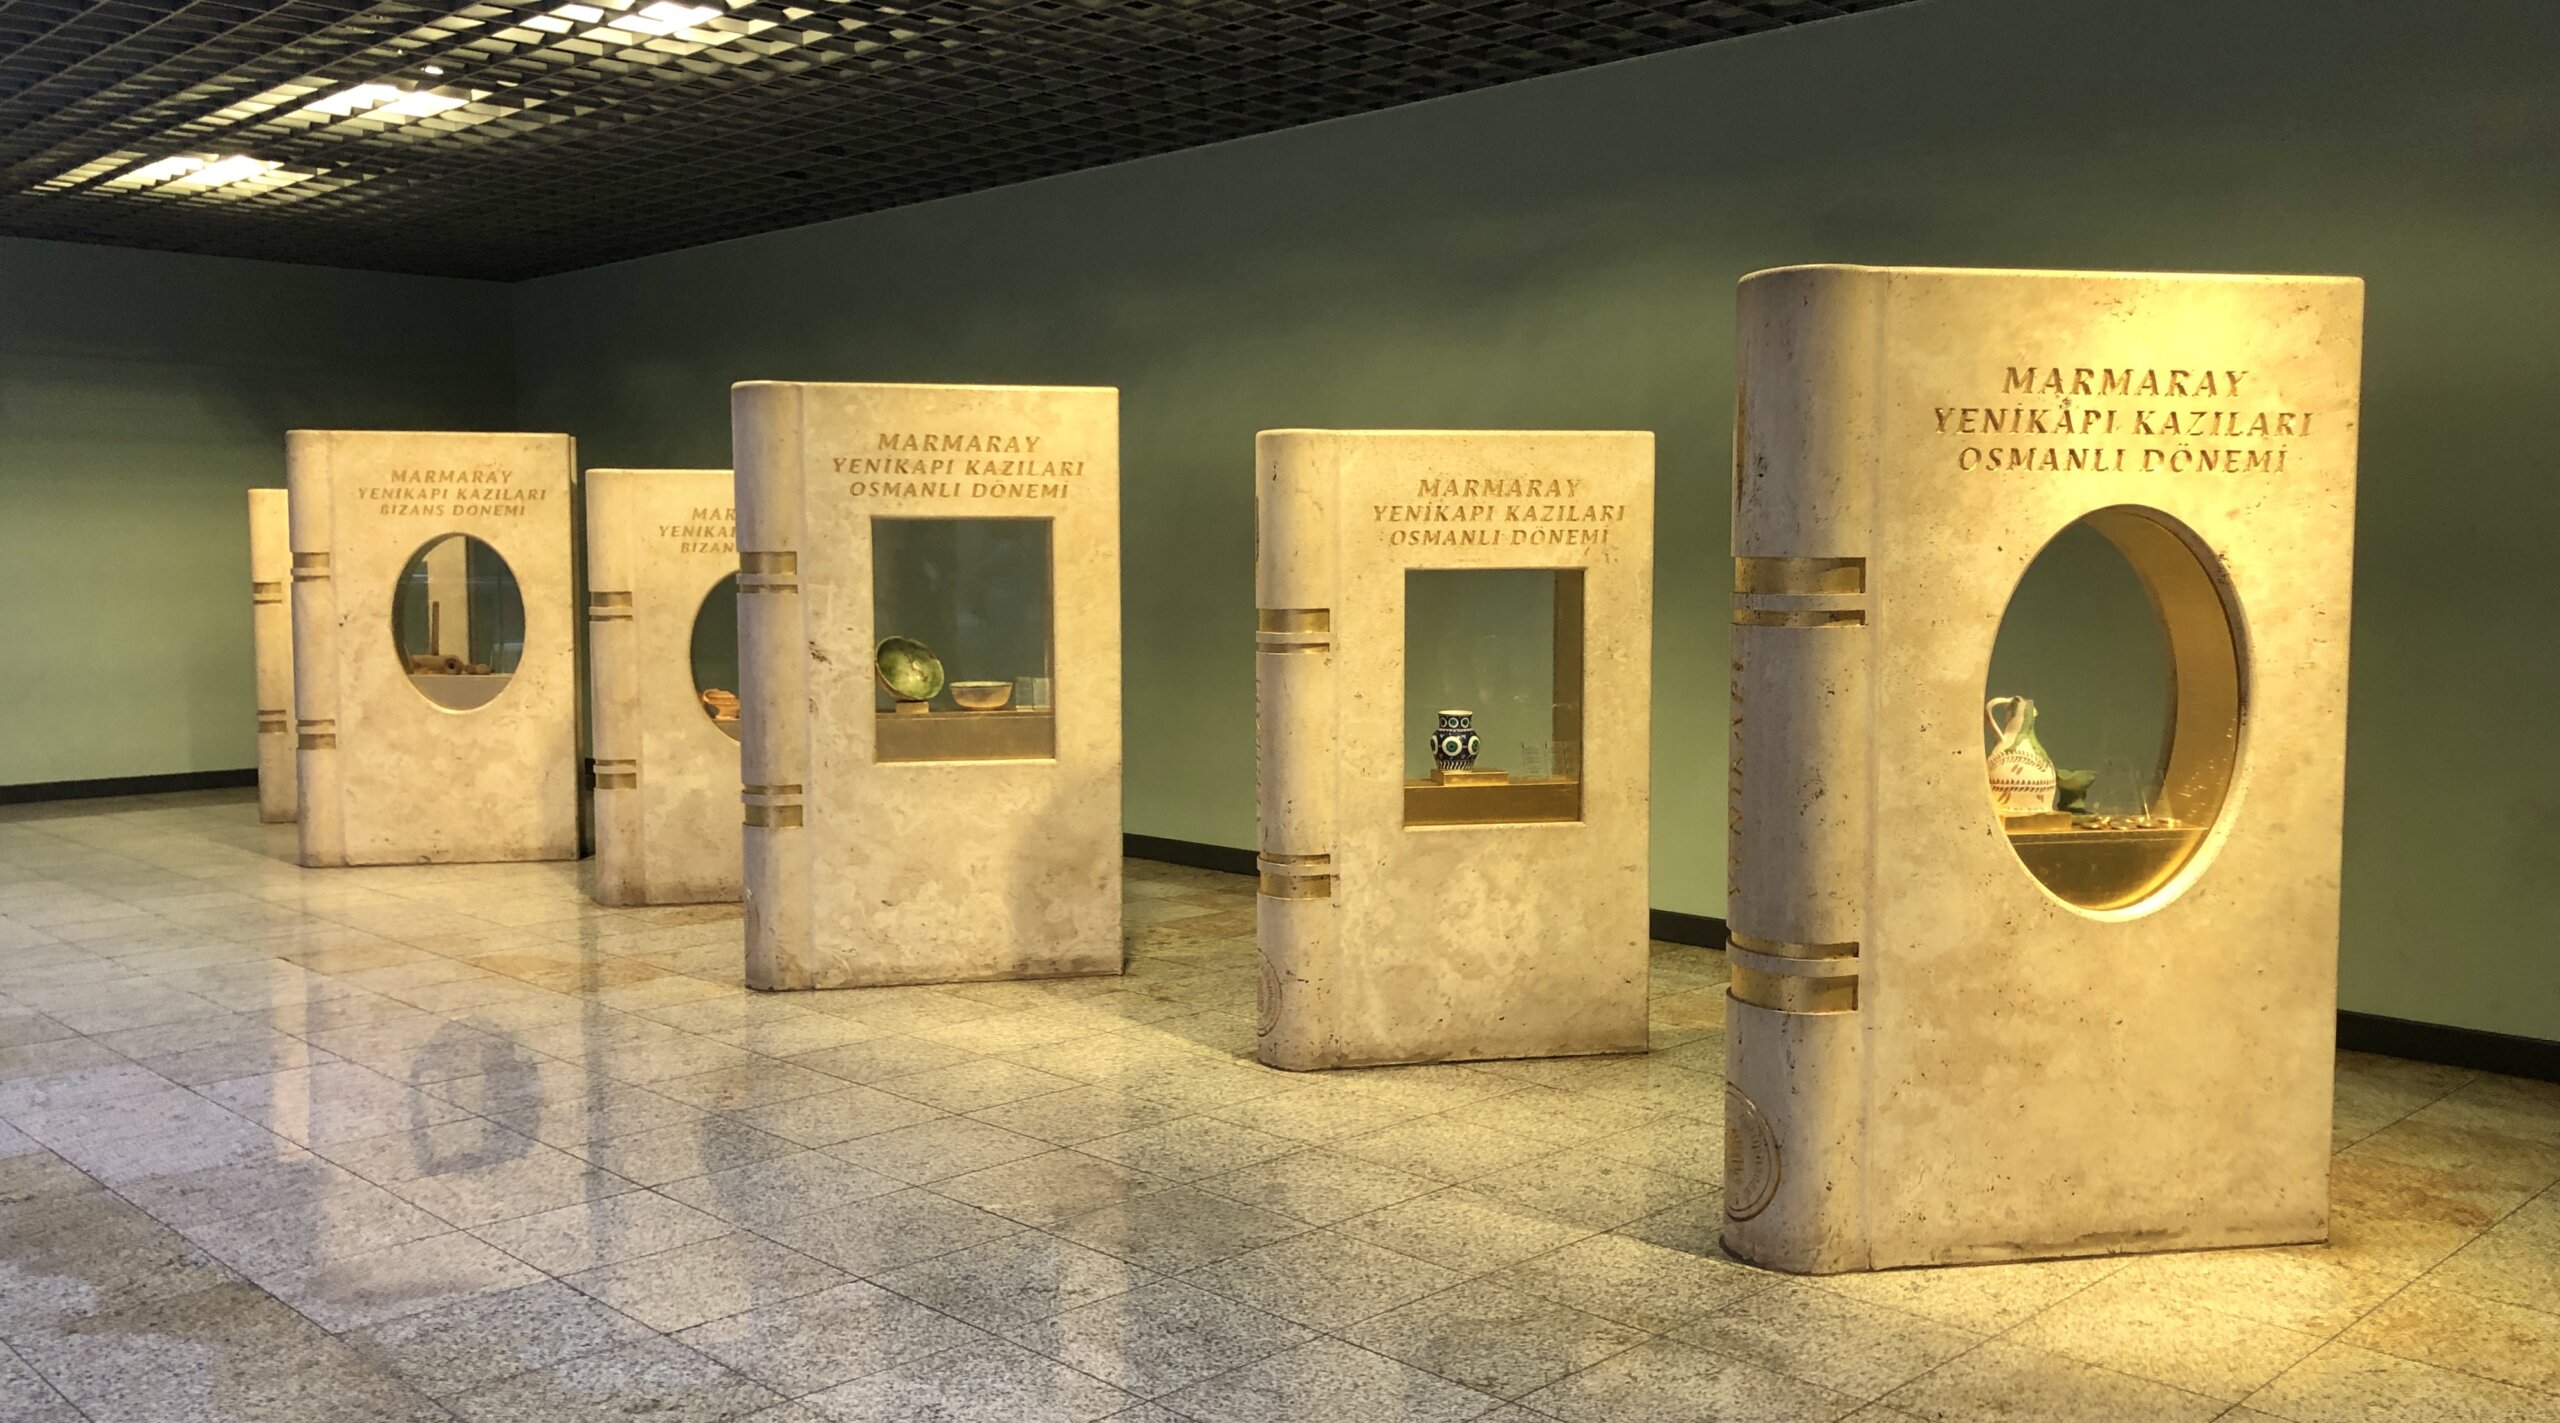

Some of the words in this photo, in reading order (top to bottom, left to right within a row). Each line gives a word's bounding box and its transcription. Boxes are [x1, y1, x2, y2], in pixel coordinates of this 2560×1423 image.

[2001, 366, 2248, 397] MARMARAY
[1933, 402, 2117, 436] YENİKAPI
[2132, 410, 2314, 437] KAZILARI
[878, 433, 1041, 453] MARMARAY
[1958, 446, 2126, 473] OSMANLI
[2140, 443, 2289, 474] DÖNEMİ
[391, 469, 513, 484] MARMARAY
[965, 460, 1085, 477] KAZILARI
[456, 488, 547, 501] KAZILARI
[850, 481, 961, 498] OSMANLI
[971, 480, 1069, 499] DÖNEMİ
[1417, 479, 1582, 498] MARMARAY
[1504, 505, 1626, 522] KAZILARI
[1389, 529, 1501, 546] OSMANLI
[1510, 526, 1610, 545] DÖNEMİ
